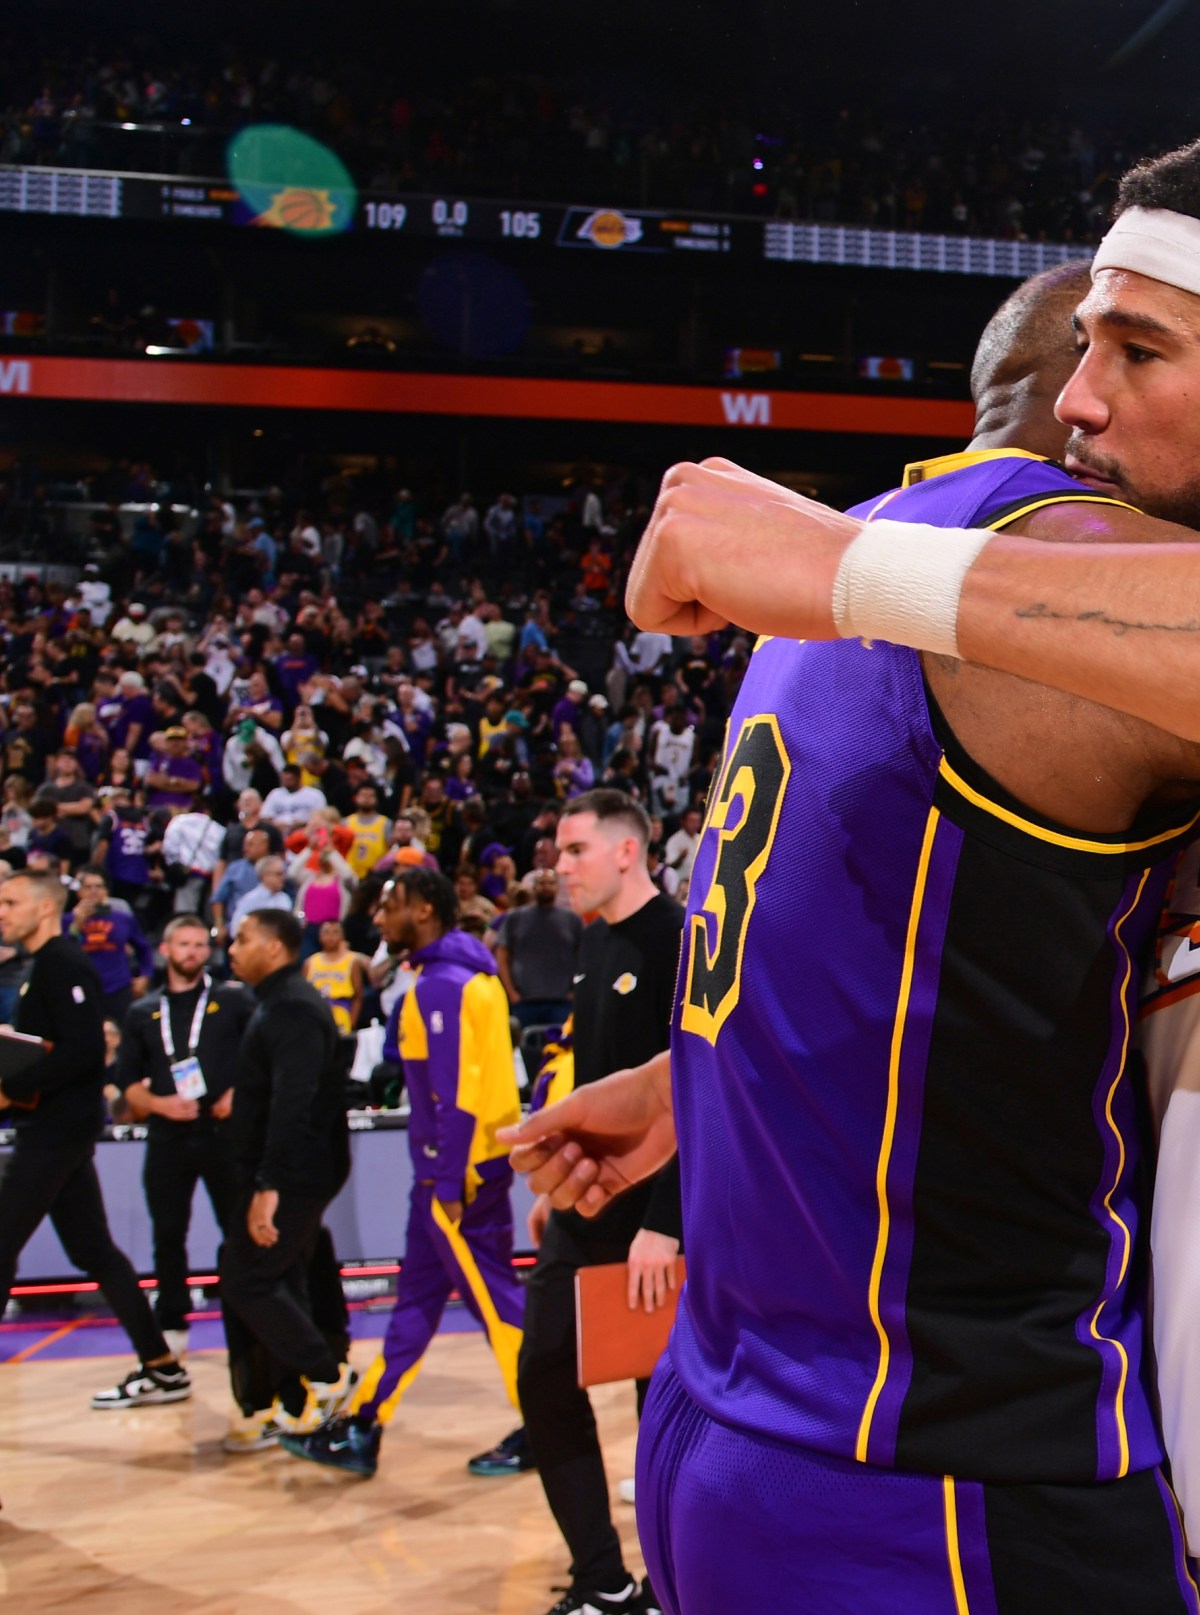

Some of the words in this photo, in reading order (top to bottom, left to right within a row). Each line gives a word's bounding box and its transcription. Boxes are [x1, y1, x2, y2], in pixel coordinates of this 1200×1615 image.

[365, 202, 406, 229] 109
[433, 199, 468, 226] 0.0
[501, 211, 540, 238] 105
[721, 393, 770, 425] WI
